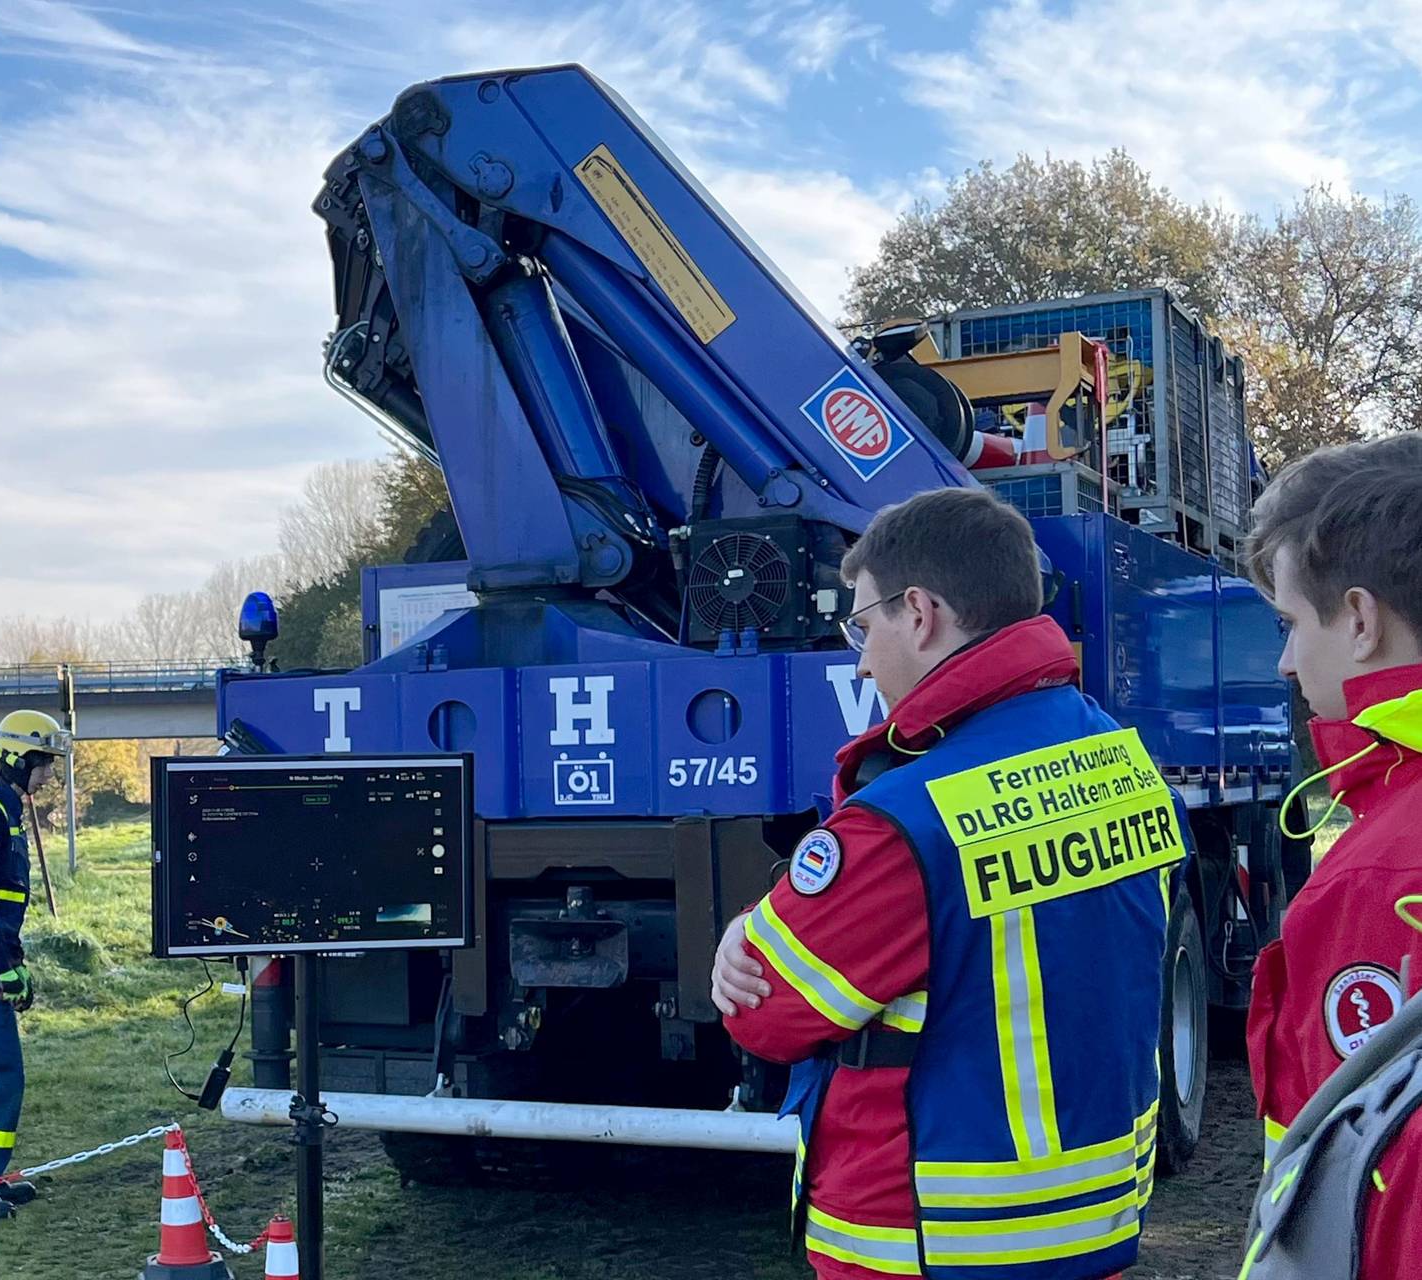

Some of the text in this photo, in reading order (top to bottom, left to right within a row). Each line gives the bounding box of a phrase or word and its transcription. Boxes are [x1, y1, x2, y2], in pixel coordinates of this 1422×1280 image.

[829, 395, 884, 448] HMF
[313, 687, 361, 752] T
[549, 675, 616, 745] H
[668, 756, 758, 787] 57/45
[987, 742, 1132, 794] Fernerkundung
[956, 766, 1157, 837] DLRG Haltern am See
[975, 805, 1178, 903] FLUGLEITER
